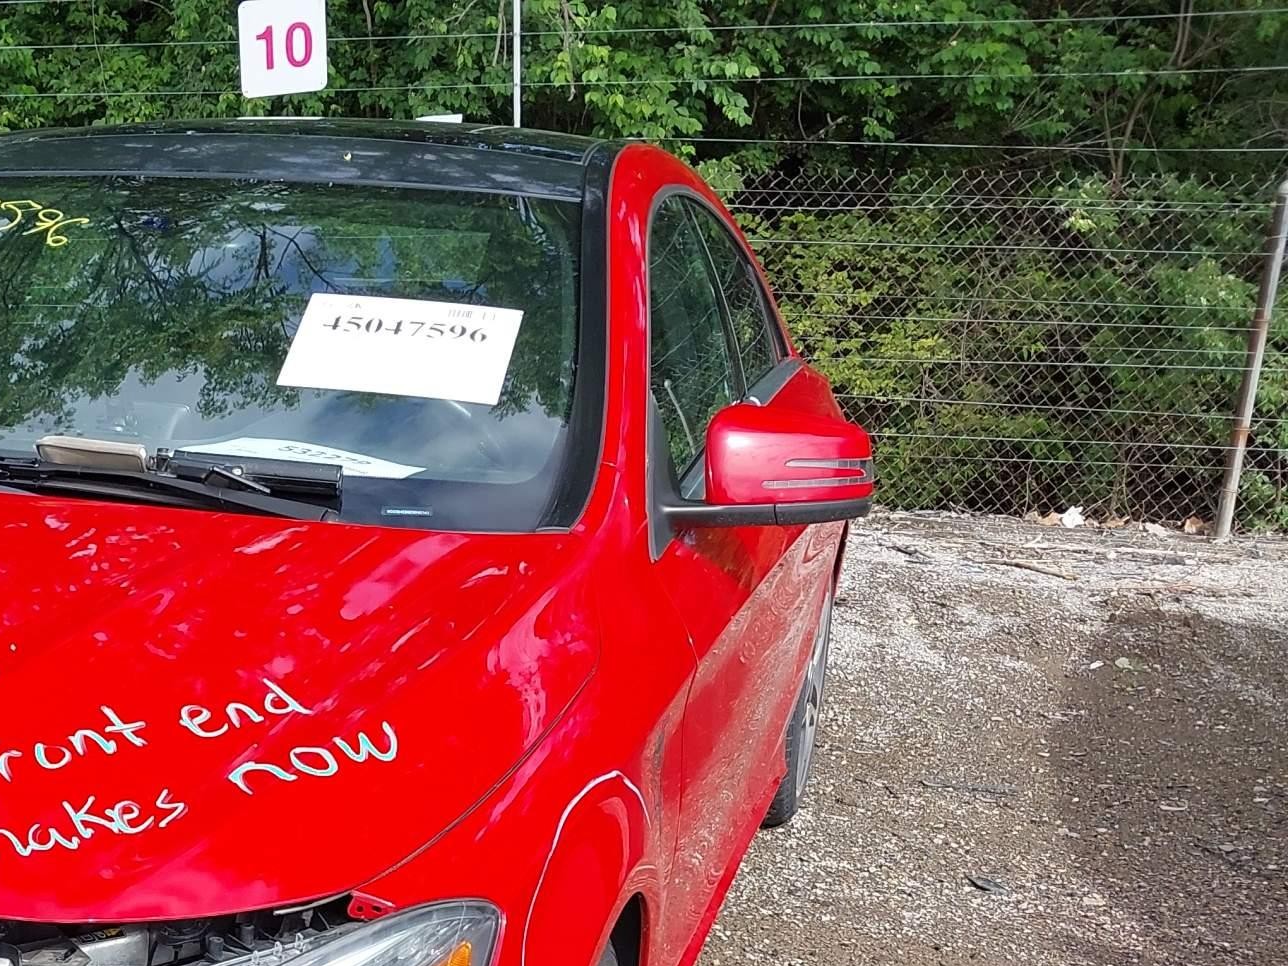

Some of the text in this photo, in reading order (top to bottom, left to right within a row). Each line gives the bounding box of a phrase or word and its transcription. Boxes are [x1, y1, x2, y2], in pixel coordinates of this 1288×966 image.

[256, 22, 313, 70] 10
[323, 315, 488, 343] 45047596
[178, 677, 313, 738] end
[228, 720, 398, 795] now
